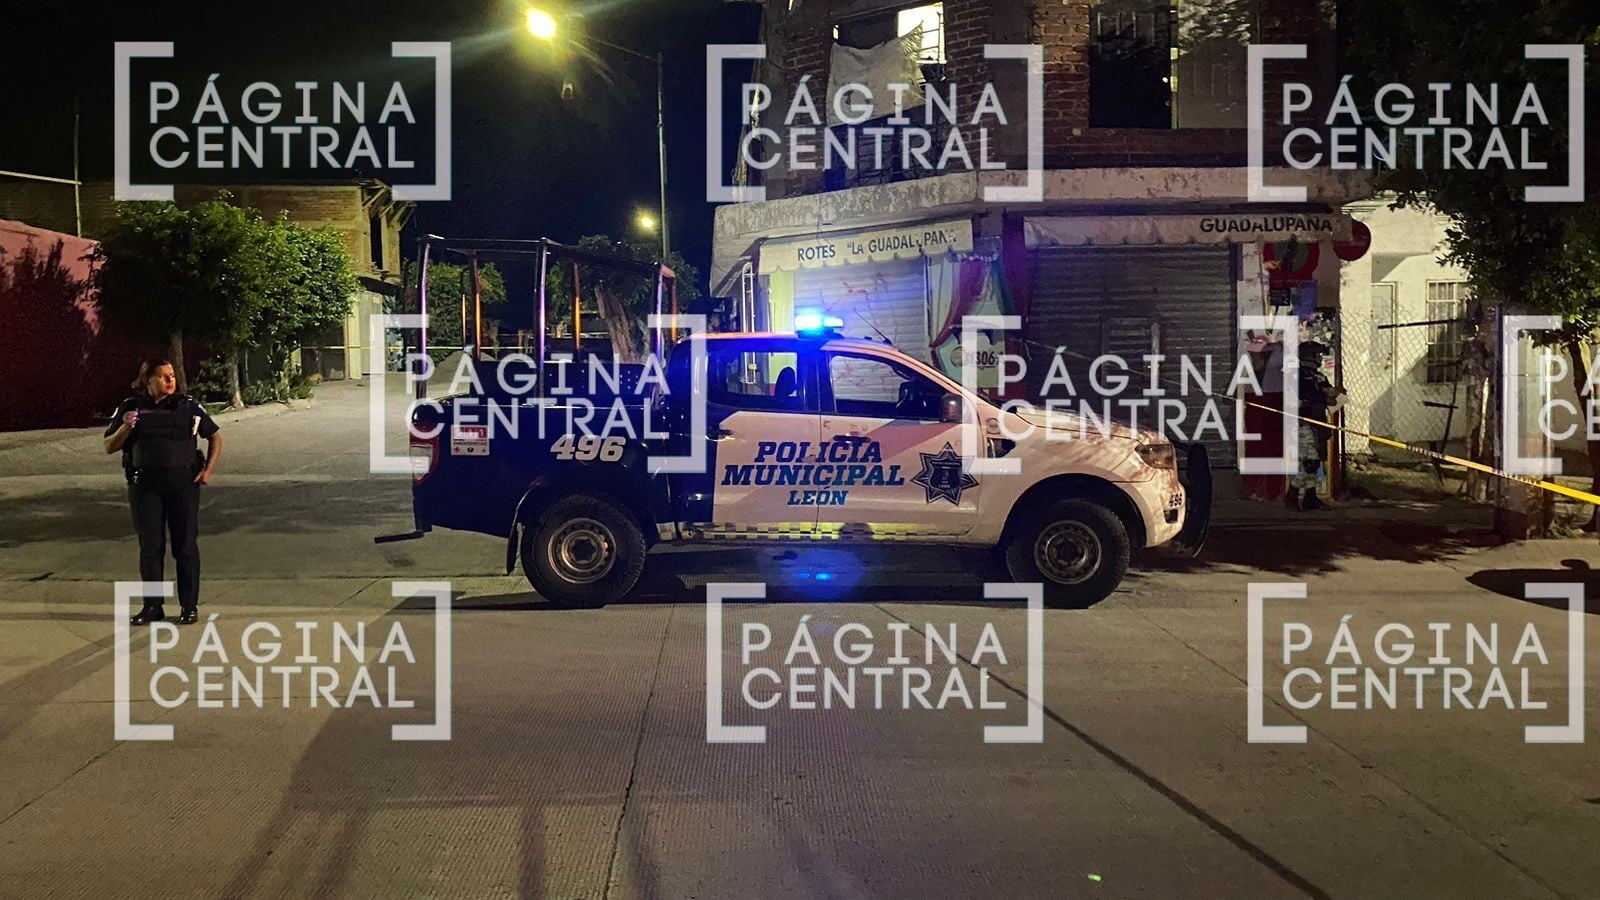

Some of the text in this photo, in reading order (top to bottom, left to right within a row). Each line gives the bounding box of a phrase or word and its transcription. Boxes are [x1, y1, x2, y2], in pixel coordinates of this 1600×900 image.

[1199, 216, 1333, 233] GUADALUPANA
[549, 434, 627, 462] 496
[721, 464, 905, 486] MUNICIPAL
[787, 486, 849, 506] LEÓN
